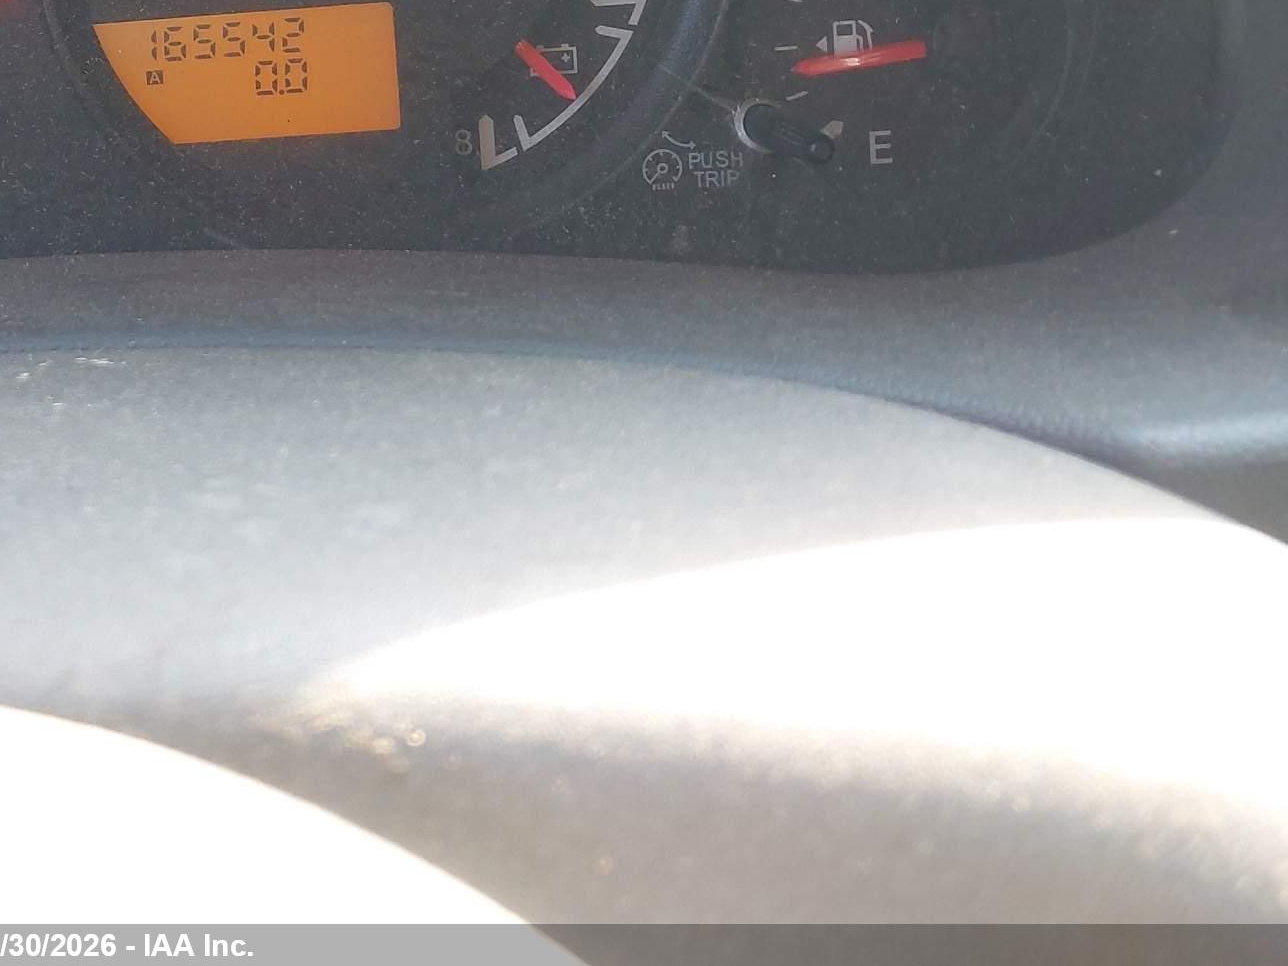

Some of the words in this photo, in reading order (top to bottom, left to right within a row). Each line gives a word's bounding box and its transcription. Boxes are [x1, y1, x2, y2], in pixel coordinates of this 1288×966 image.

[151, 17, 306, 61] 165542
[255, 57, 308, 96] 0.0
[455, 129, 473, 156] 8
[869, 130, 894, 165] E
[688, 150, 744, 170] PUSH
[694, 169, 740, 188] TRIP
